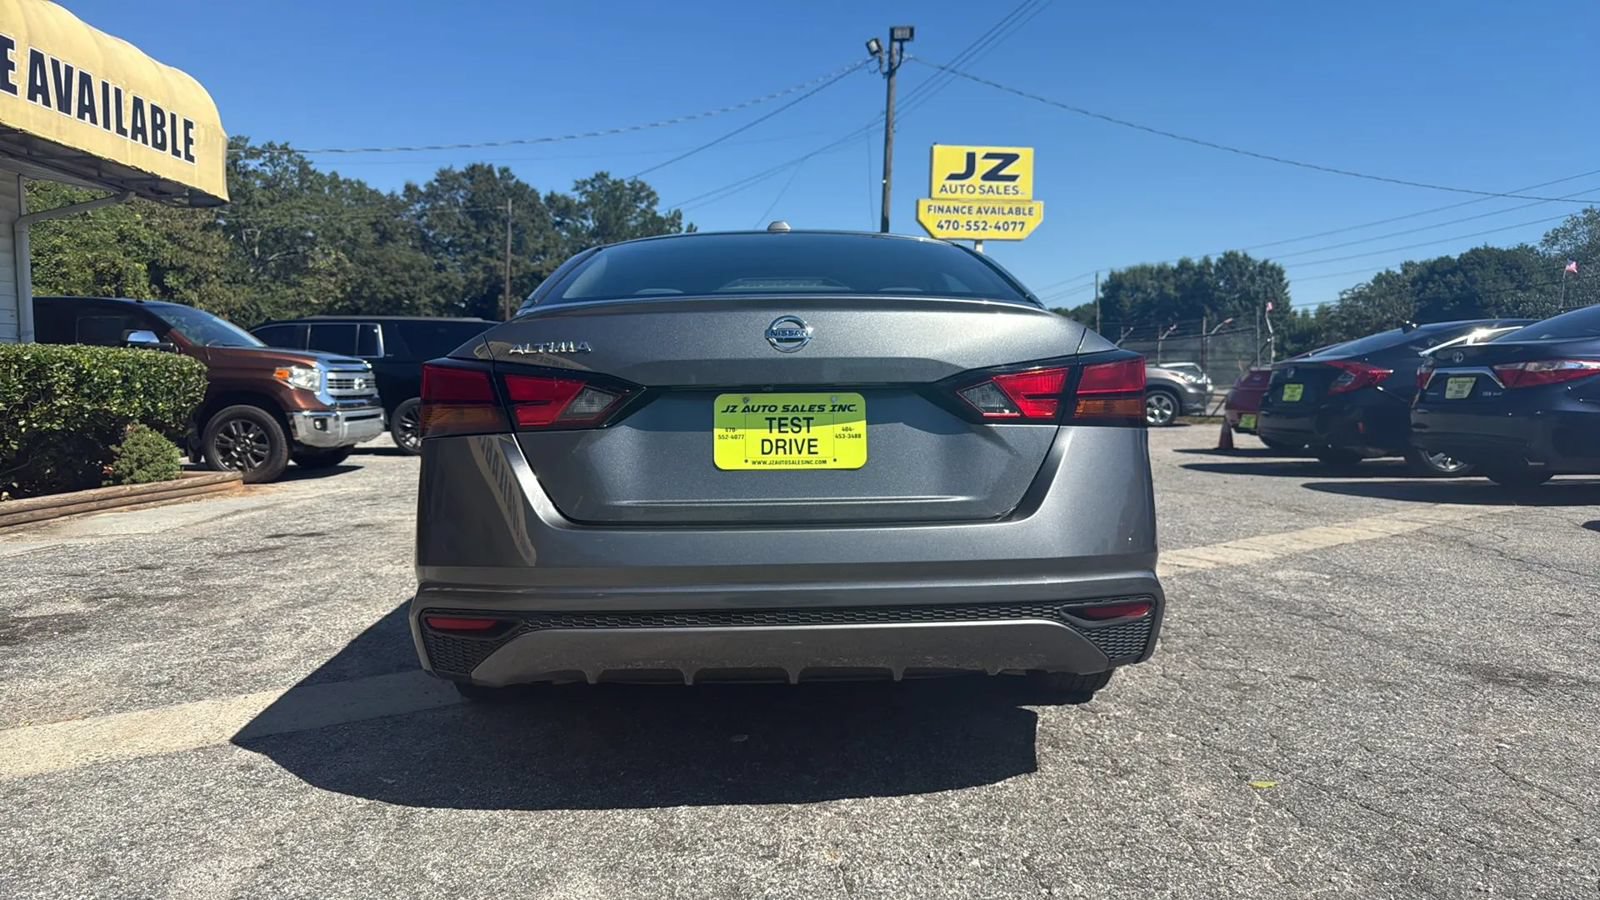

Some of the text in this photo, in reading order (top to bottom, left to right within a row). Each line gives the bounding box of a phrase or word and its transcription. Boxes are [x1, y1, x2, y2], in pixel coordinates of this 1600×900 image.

[27, 48, 195, 164] AVAILABLE
[945, 152, 1020, 182] JZ
[939, 184, 976, 194] AUTO
[978, 185, 1019, 195] SALES
[927, 205, 1034, 216] FINANCE AVAILABLE
[936, 220, 1025, 231] 470-552-4077
[770, 329, 808, 337] NISSAN
[508, 342, 592, 354] ALTIMA
[721, 404, 857, 413] JZ AUTO SALES INC.
[765, 417, 814, 434] TEST
[761, 439, 818, 455] DRIVE
